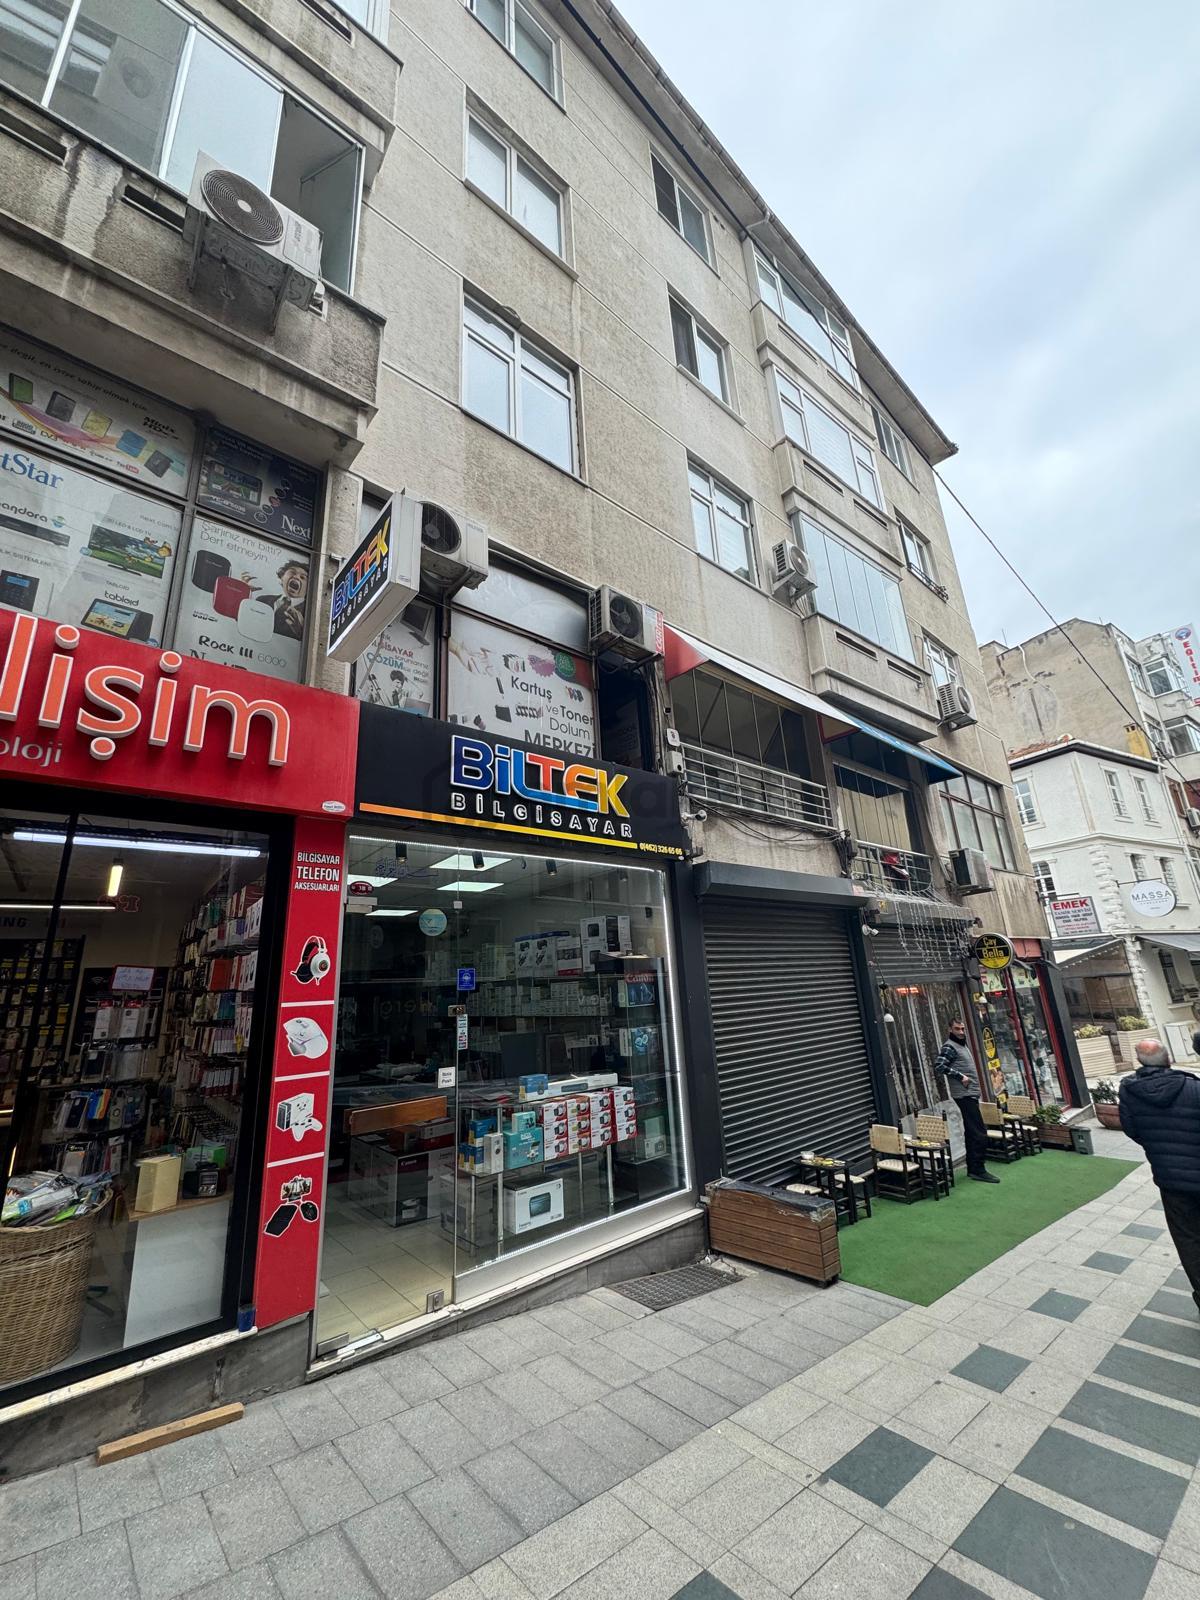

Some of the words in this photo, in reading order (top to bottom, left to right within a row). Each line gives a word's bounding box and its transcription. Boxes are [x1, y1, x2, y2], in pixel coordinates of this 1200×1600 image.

[0, 502, 48, 523] andora
[281, 514, 312, 540] Next
[104, 590, 140, 607] tabloid
[511, 675, 553, 701] Kartuş
[546, 703, 559, 717] ve
[560, 704, 595, 727] Toner
[549, 717, 591, 740] Dolum
[451, 792, 632, 838] BİLGİSAYAR
[296, 865, 340, 882] TELEFON
[294, 881, 340, 892] AKSESUARLARI
[1131, 890, 1172, 901] MASSA
[1053, 899, 1089, 911] EMEK
[982, 948, 1004, 958] Bella
